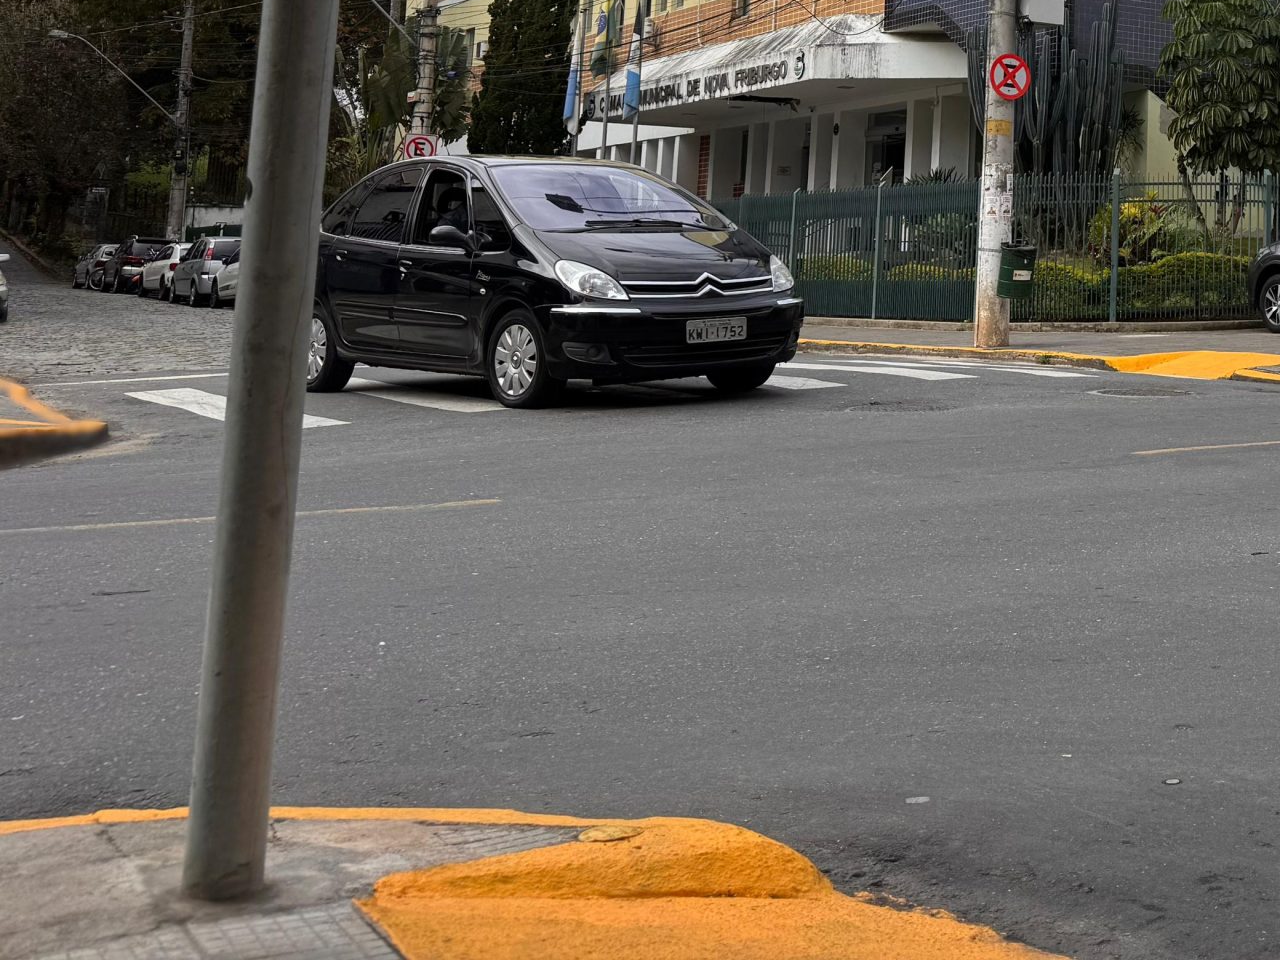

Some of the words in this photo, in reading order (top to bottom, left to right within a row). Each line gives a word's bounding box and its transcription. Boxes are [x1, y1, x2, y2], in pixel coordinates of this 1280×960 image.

[687, 77, 701, 98] DE
[704, 72, 729, 95] NOVA
[734, 60, 788, 90] FRIBURGO
